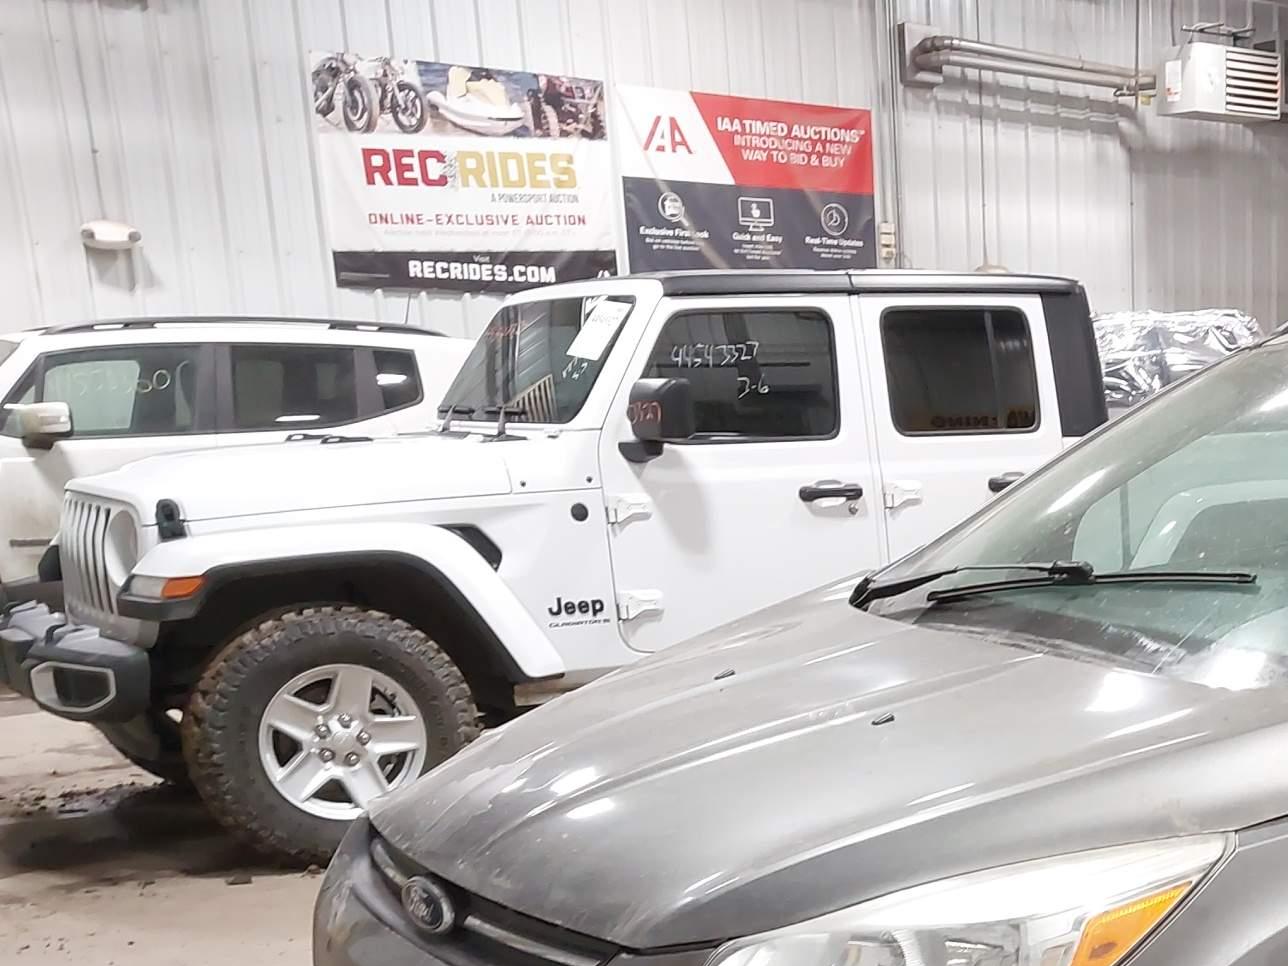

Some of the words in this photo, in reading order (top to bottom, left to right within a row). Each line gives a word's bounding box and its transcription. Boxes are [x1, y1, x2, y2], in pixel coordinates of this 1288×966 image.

[716, 117, 742, 132] IAA
[744, 119, 788, 137] TIMED
[733, 135, 811, 153] INTRODUCING
[814, 143, 823, 153] A
[825, 144, 852, 155] NEW
[741, 150, 769, 162] WAY
[770, 152, 788, 163] TO
[790, 153, 808, 165] BID
[809, 155, 819, 166] &
[822, 156, 845, 168] BUY
[361, 148, 449, 187] REC
[455, 151, 578, 189] RIDES
[549, 193, 579, 204] AUCTION
[368, 213, 519, 226] ONLINE-EXCLUSIVE
[526, 214, 587, 226] AUCTION
[640, 226, 674, 236] Exclusive
[732, 231, 751, 241] Quick
[766, 233, 783, 244] Easy
[805, 236, 838, 245] Real-Time
[839, 238, 864, 248] Updates
[408, 260, 557, 284] RECRIDES.COM
[548, 597, 605, 617] Jeep
